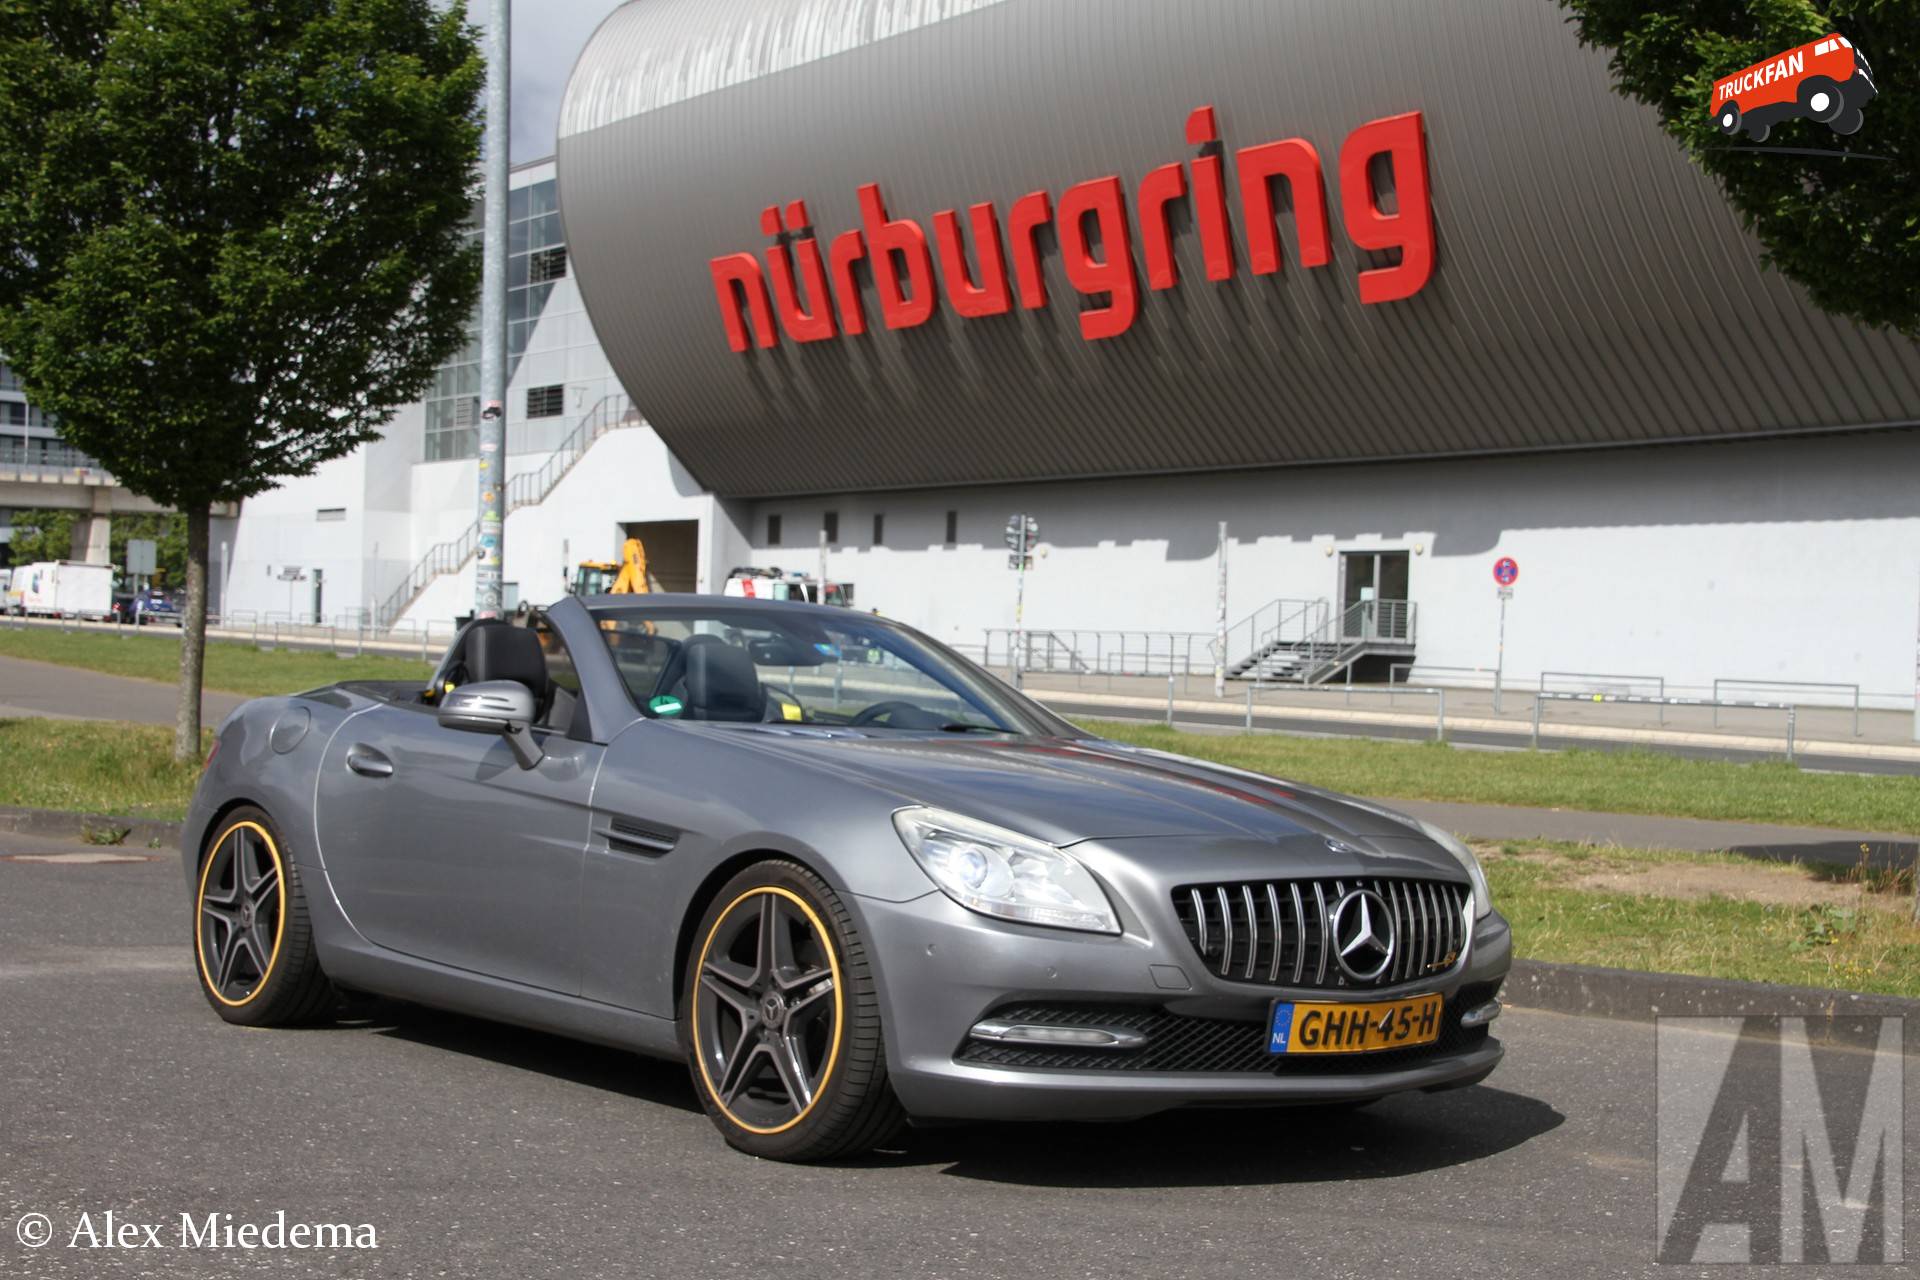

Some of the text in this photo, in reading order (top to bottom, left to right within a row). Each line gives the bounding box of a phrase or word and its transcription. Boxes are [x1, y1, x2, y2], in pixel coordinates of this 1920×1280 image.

[710, 105, 1437, 353] nürburgring
[1272, 1033, 1286, 1044] NL
[1298, 1001, 1438, 1047] GHH-45-H
